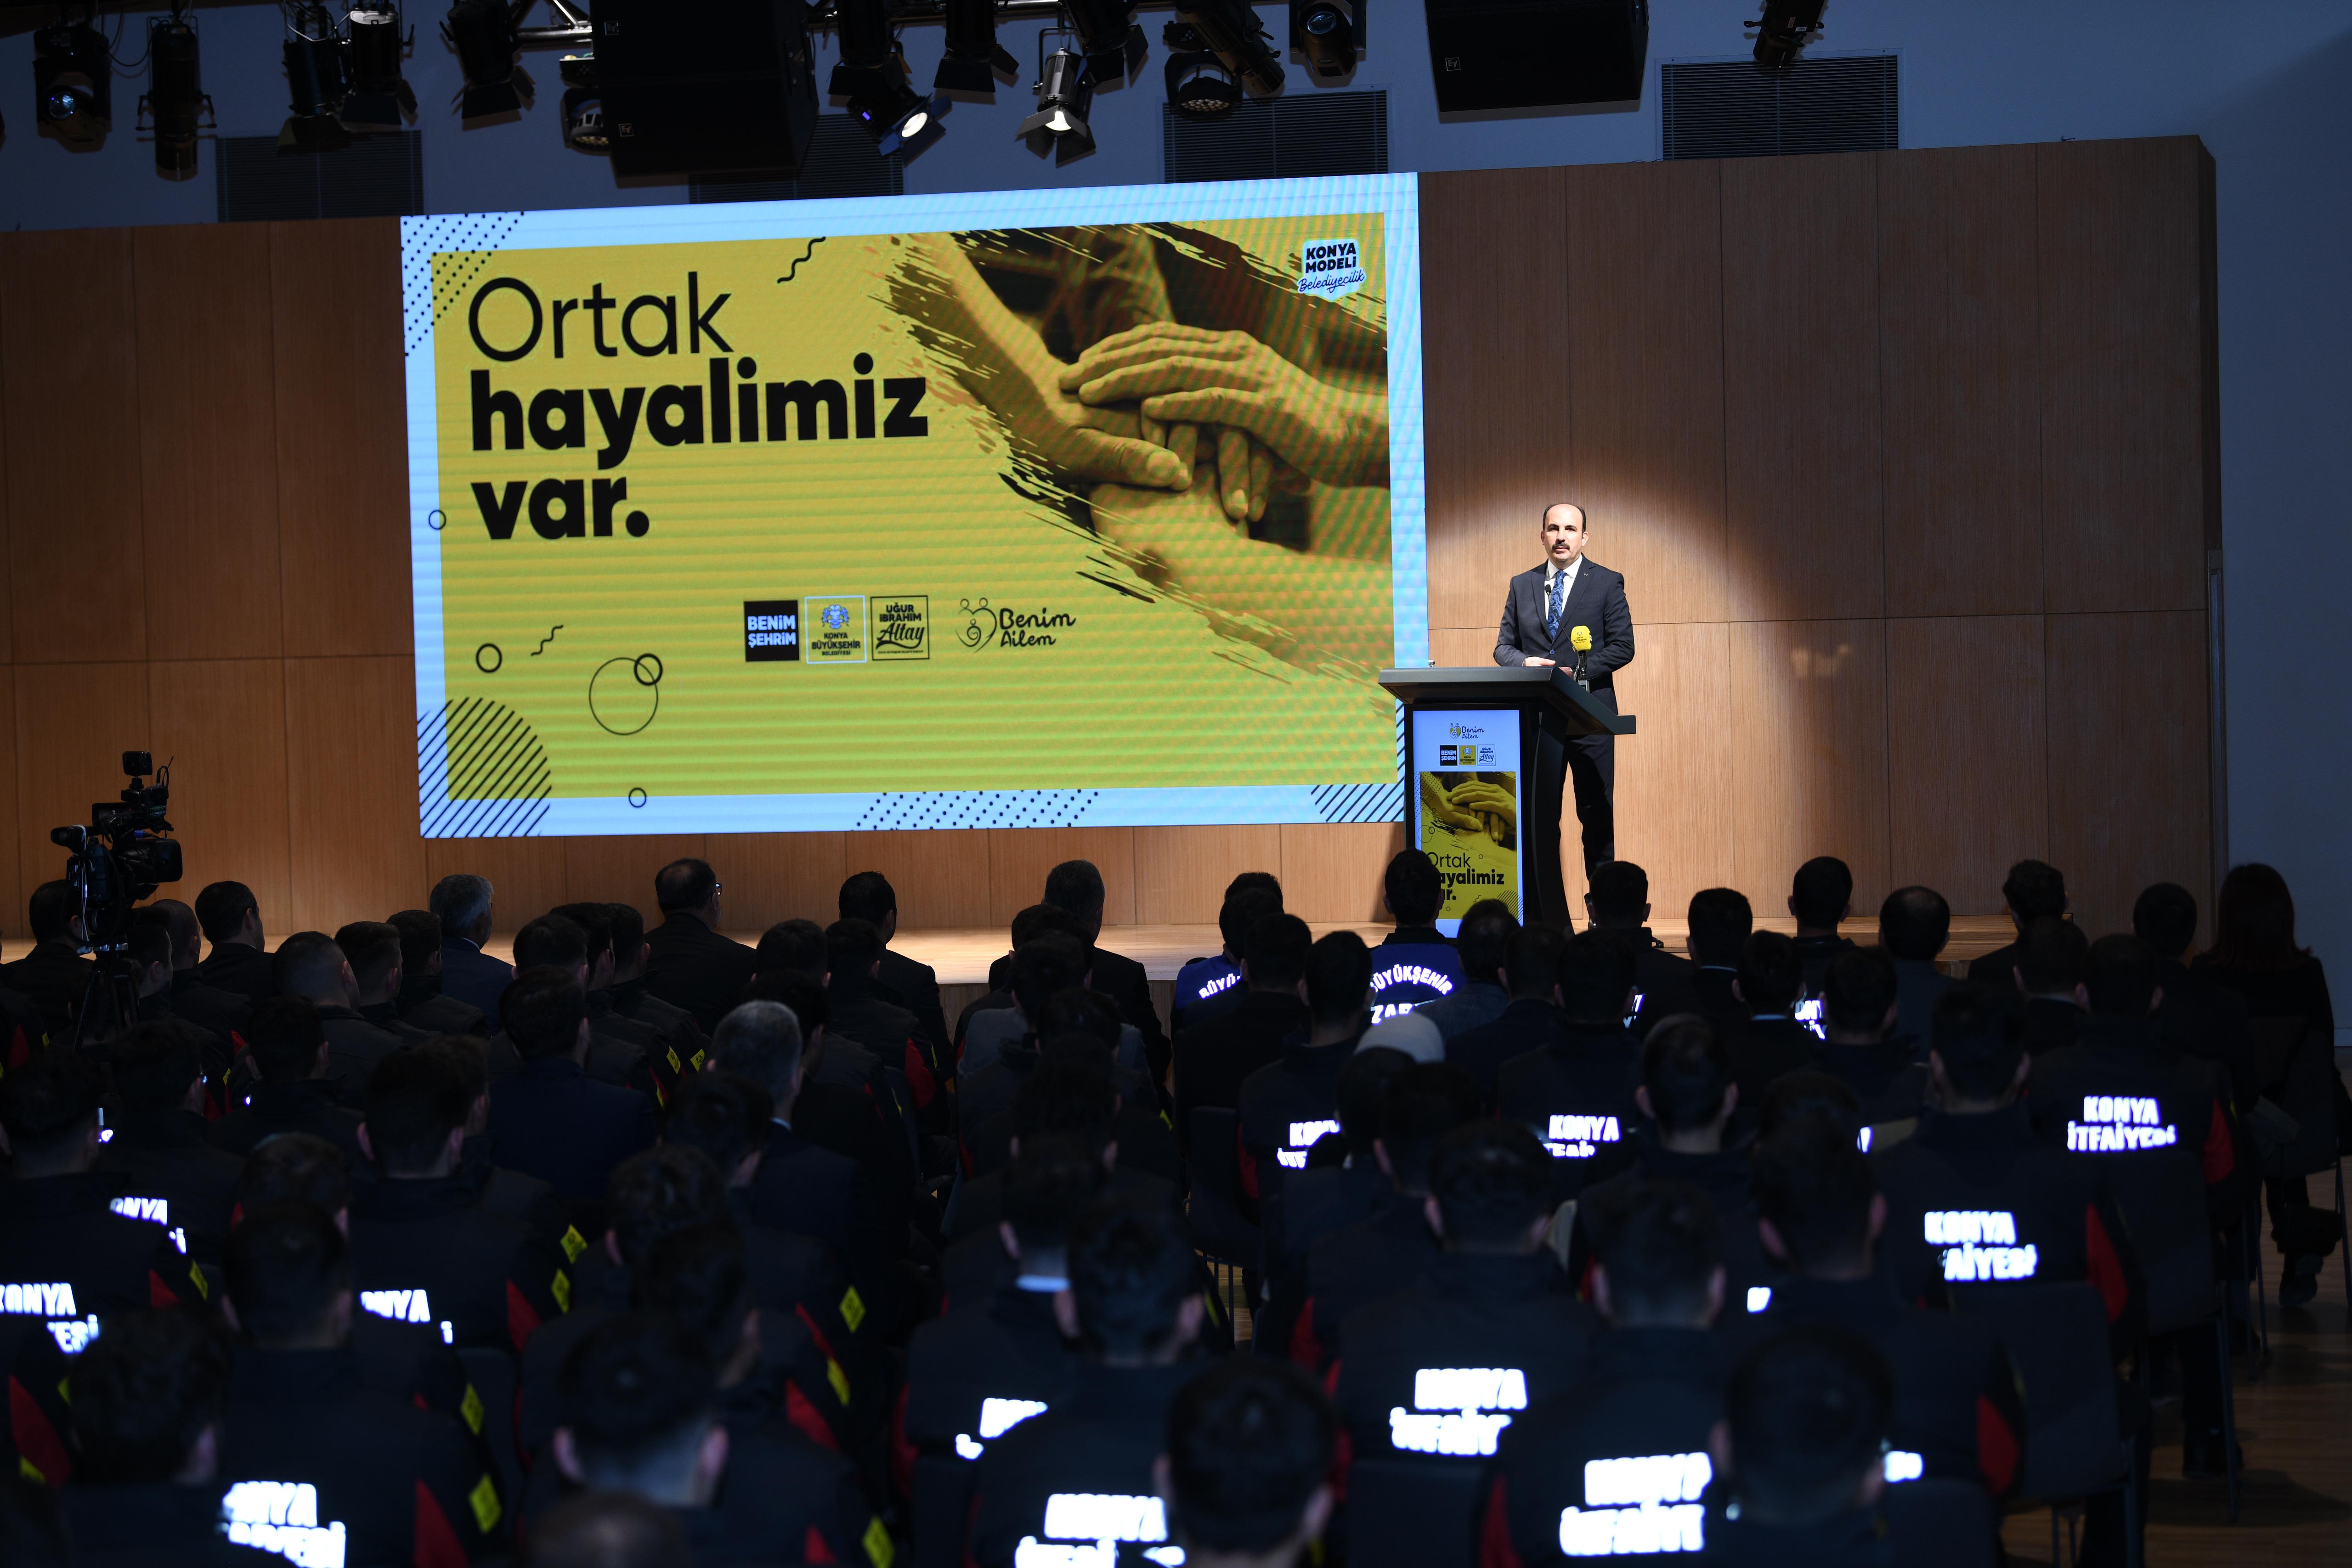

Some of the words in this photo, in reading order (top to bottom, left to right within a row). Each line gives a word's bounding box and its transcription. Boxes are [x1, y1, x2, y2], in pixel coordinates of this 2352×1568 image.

[1306, 243, 1357, 260] KONYA
[1298, 269, 1365, 293] Belediyecilik
[468, 271, 734, 362] Ortak
[470, 352, 928, 470] hayalimiz
[471, 476, 650, 539] var.
[886, 602, 914, 613] UĞUR
[1000, 607, 1076, 630] Benim
[876, 622, 925, 649] Altay
[1001, 630, 1056, 647] Ailem
[2083, 1096, 2159, 1125] KONYA
[1548, 1114, 1620, 1141] KONYA
[1925, 1211, 2016, 1245] KONYA
